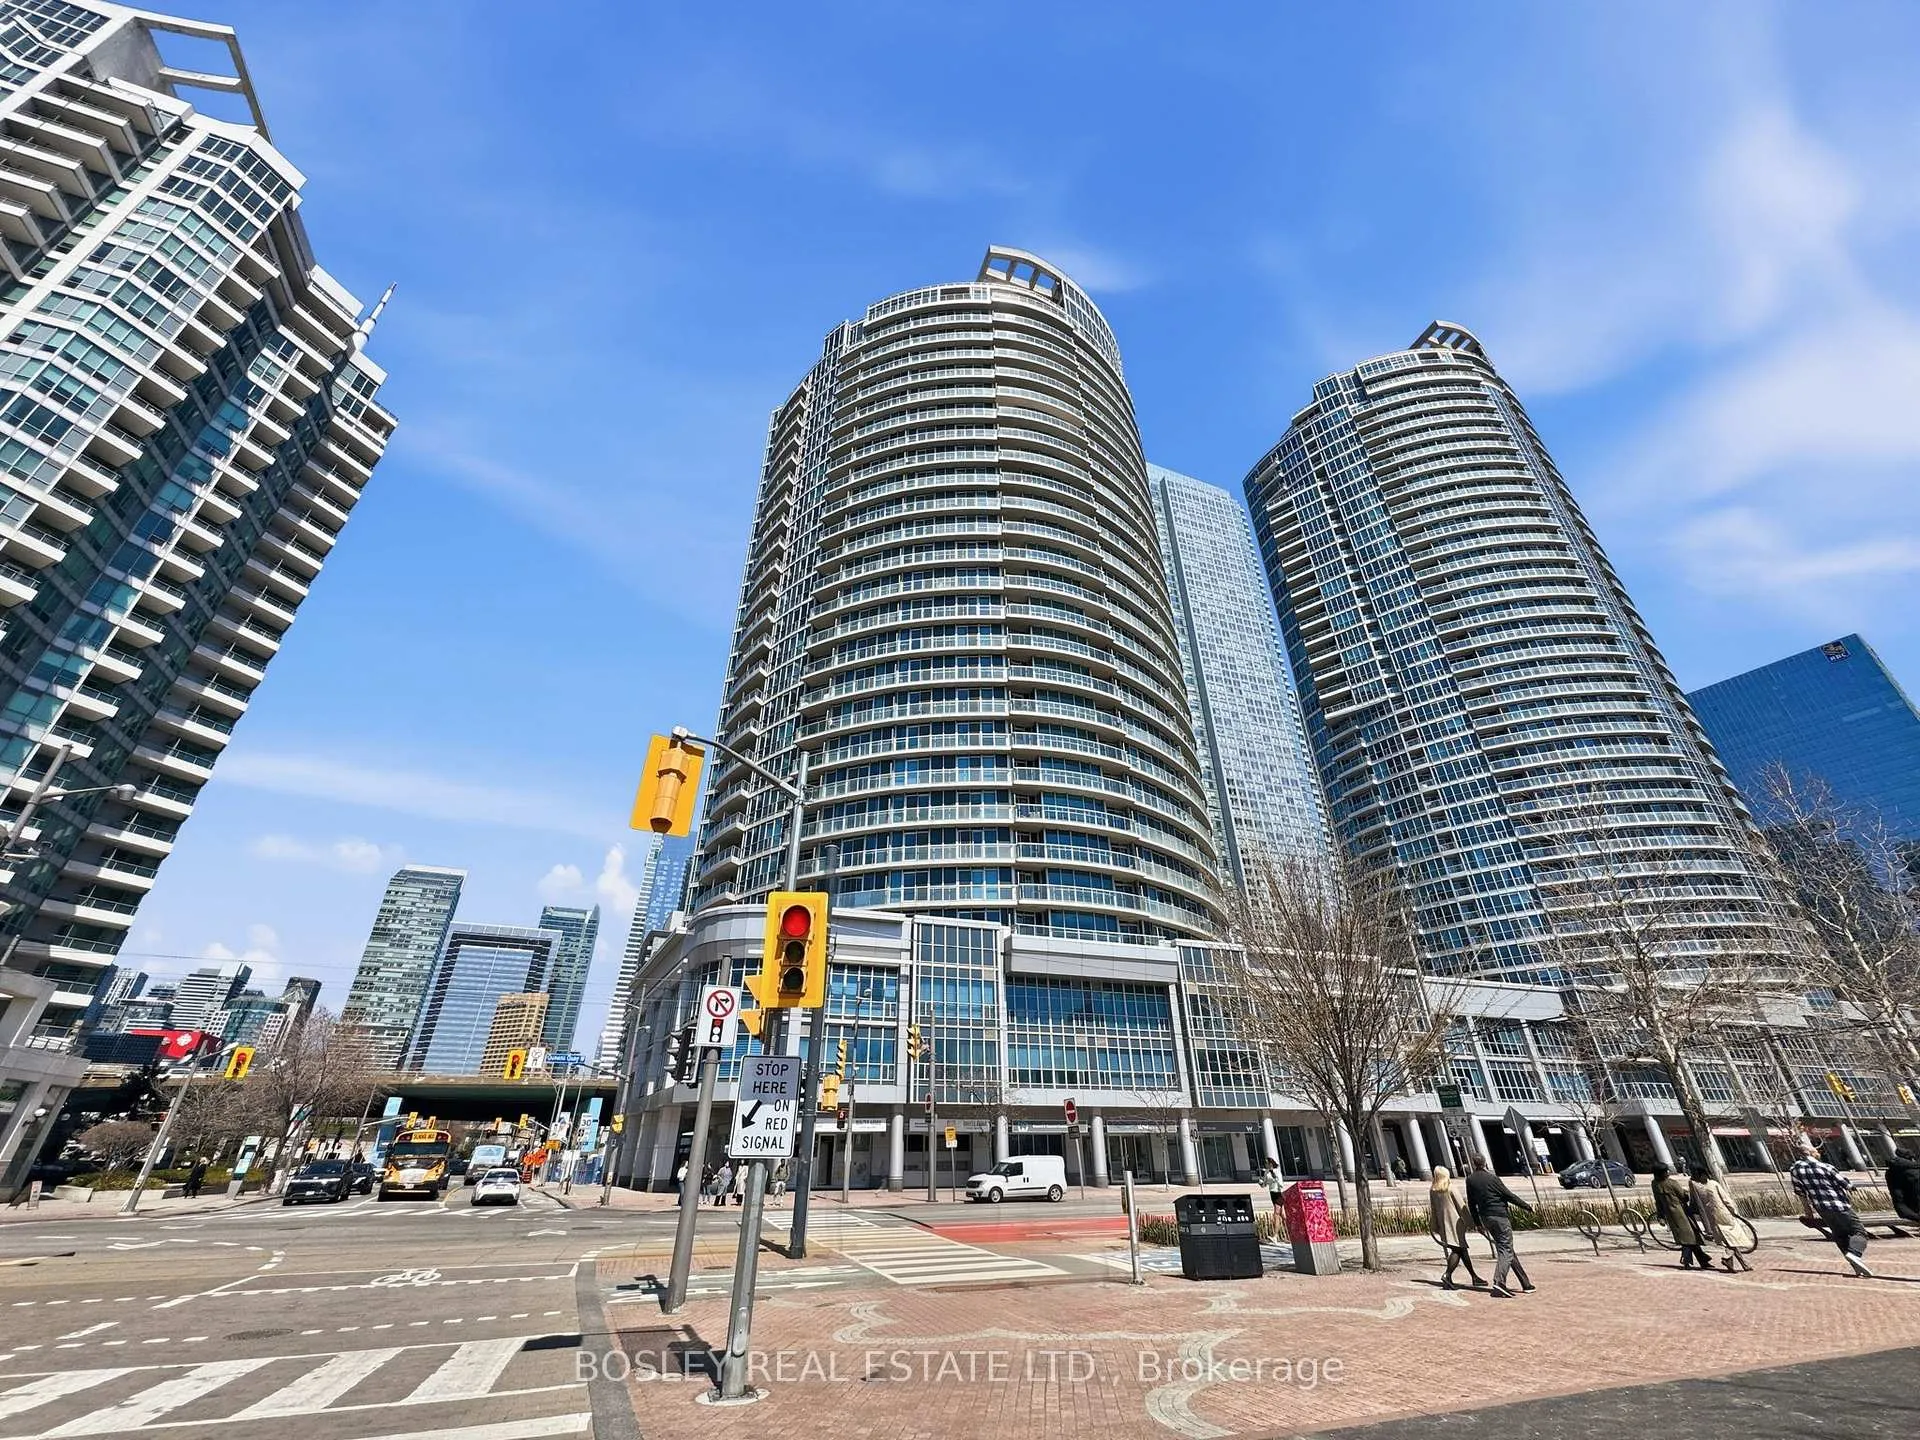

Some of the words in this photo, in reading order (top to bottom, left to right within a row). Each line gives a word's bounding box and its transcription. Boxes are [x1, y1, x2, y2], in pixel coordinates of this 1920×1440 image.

[756, 1063, 789, 1076] STOP
[753, 1081, 787, 1094] HERE
[774, 1099, 790, 1112] ON
[581, 1119, 592, 1127] 30
[765, 1117, 788, 1131] RED
[742, 1135, 785, 1150] SIGNAL
